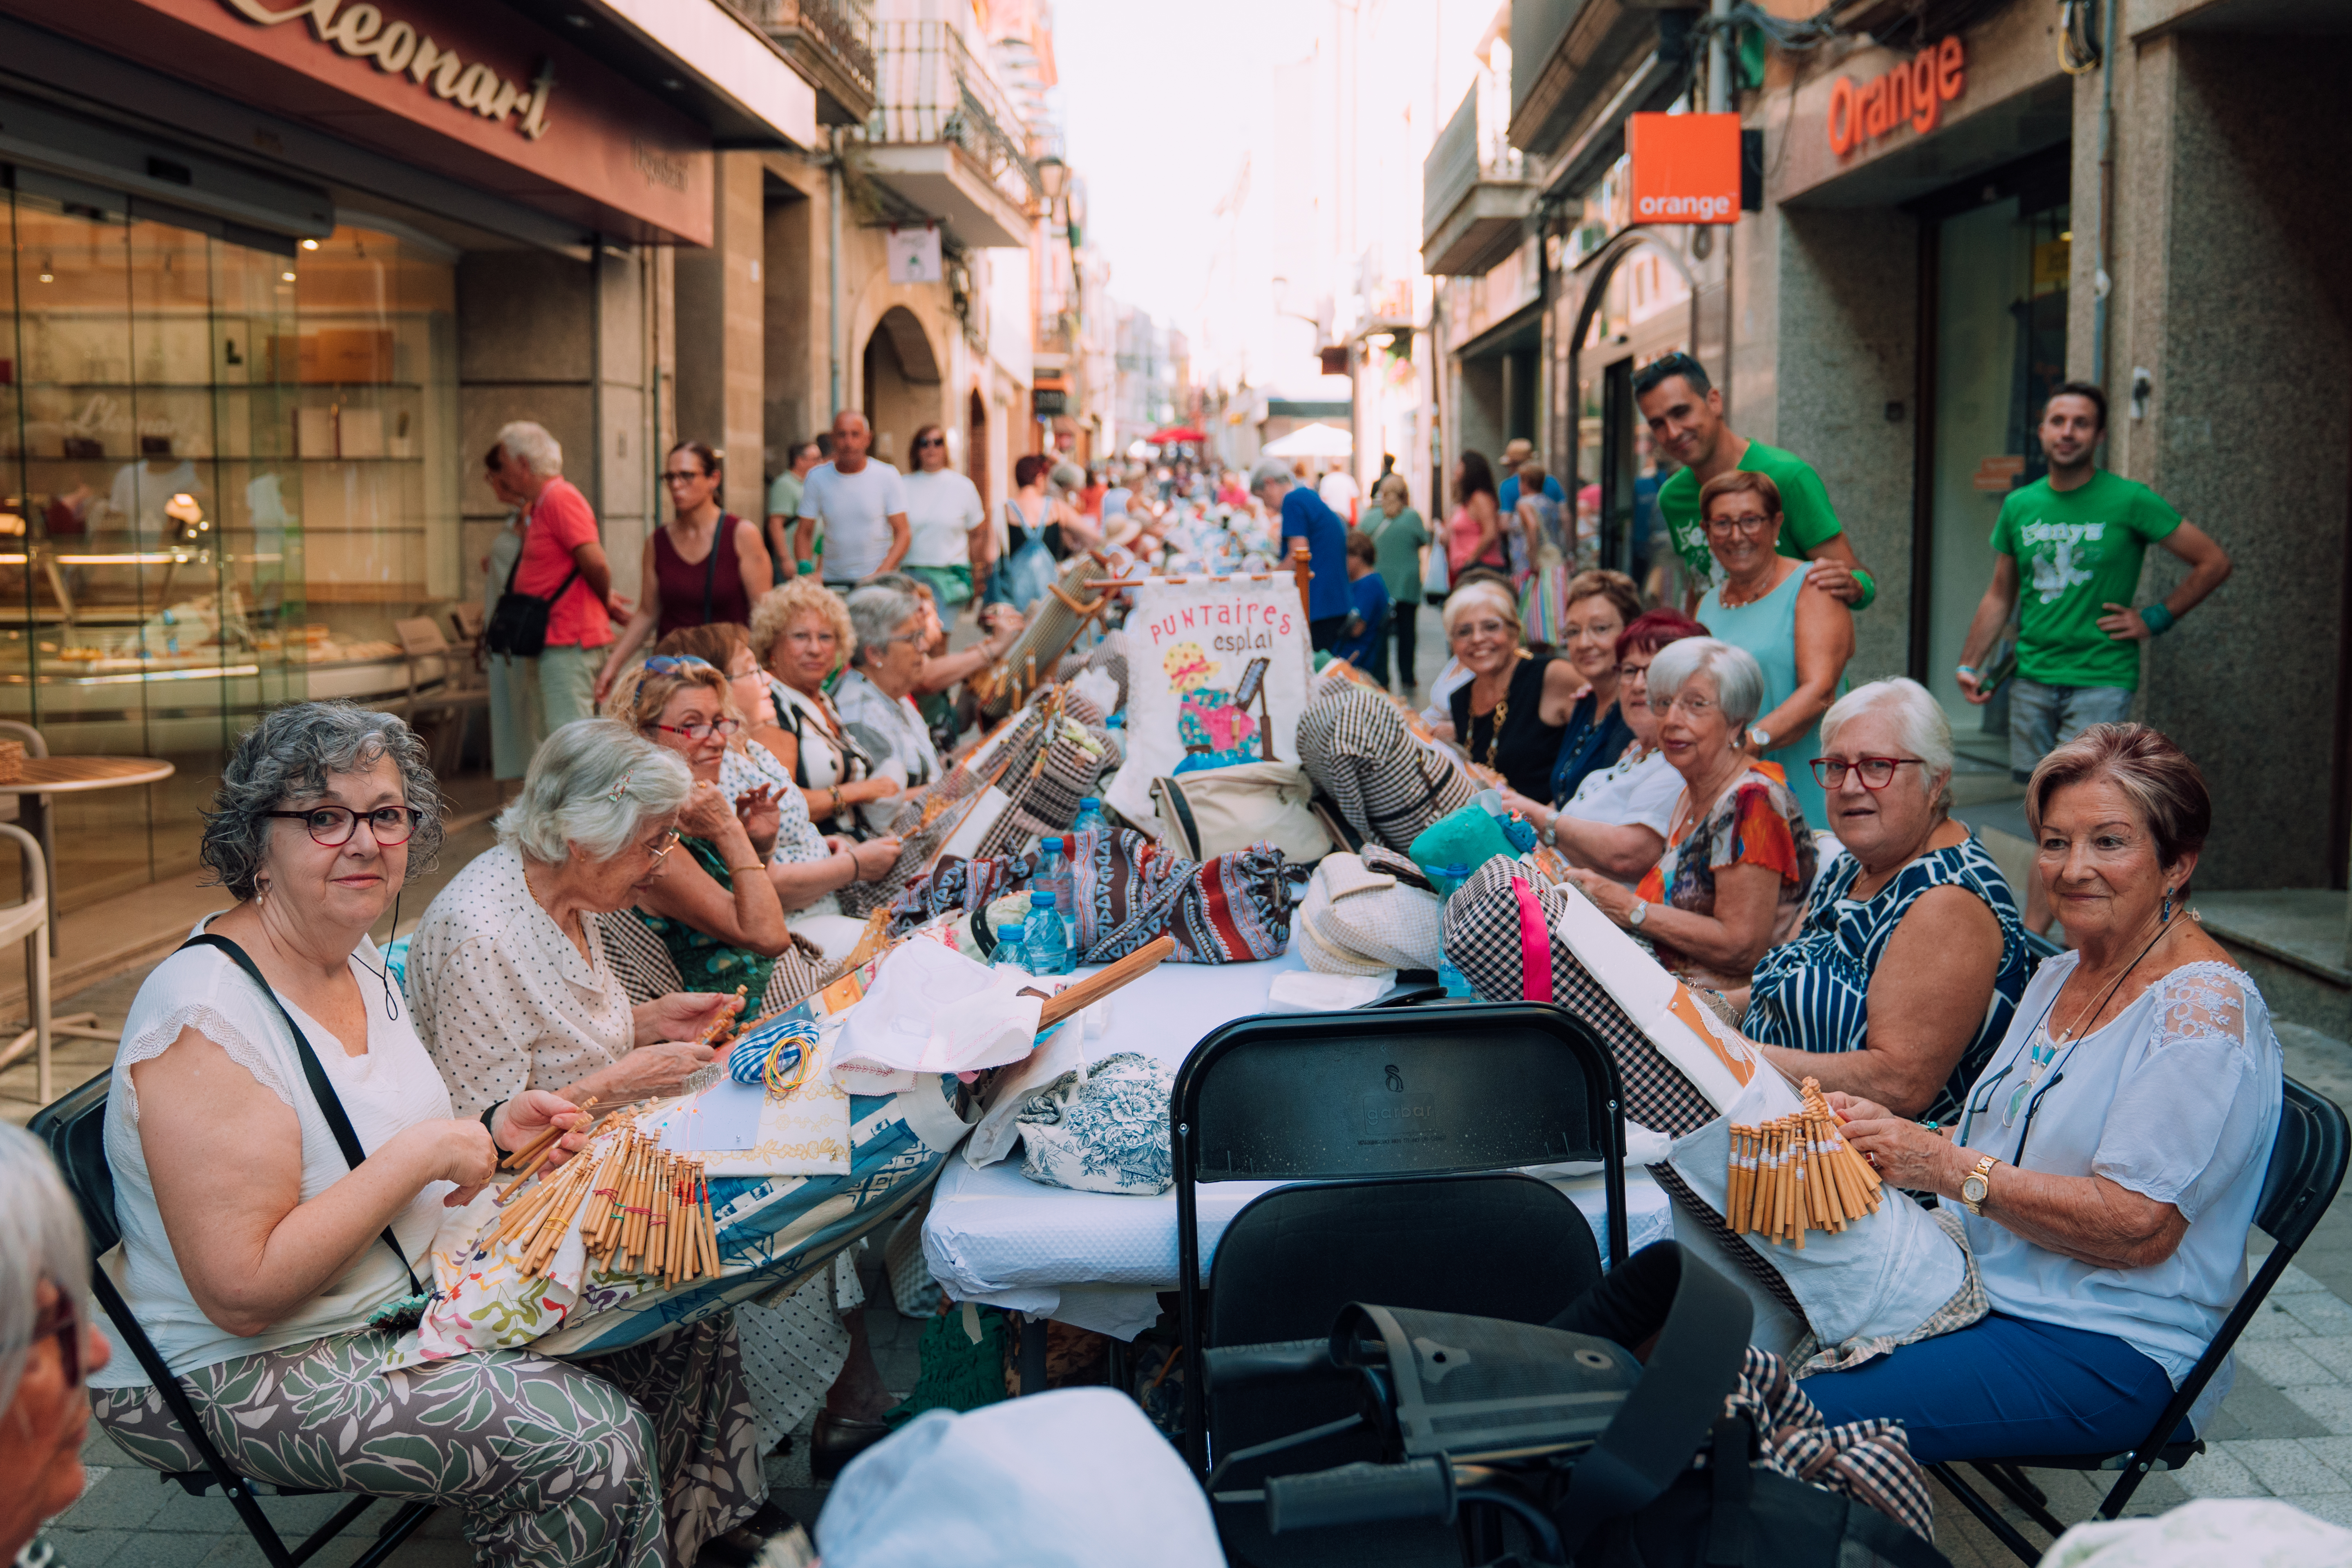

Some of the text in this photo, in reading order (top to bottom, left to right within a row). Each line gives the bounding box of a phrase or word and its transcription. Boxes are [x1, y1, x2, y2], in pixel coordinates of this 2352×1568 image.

[233, 0, 551, 140] eonart
[1828, 34, 1964, 156] Orange
[1639, 195, 1730, 221] orange
[1214, 626, 1273, 655] esplai
[1366, 1104, 1432, 1126] garbar
